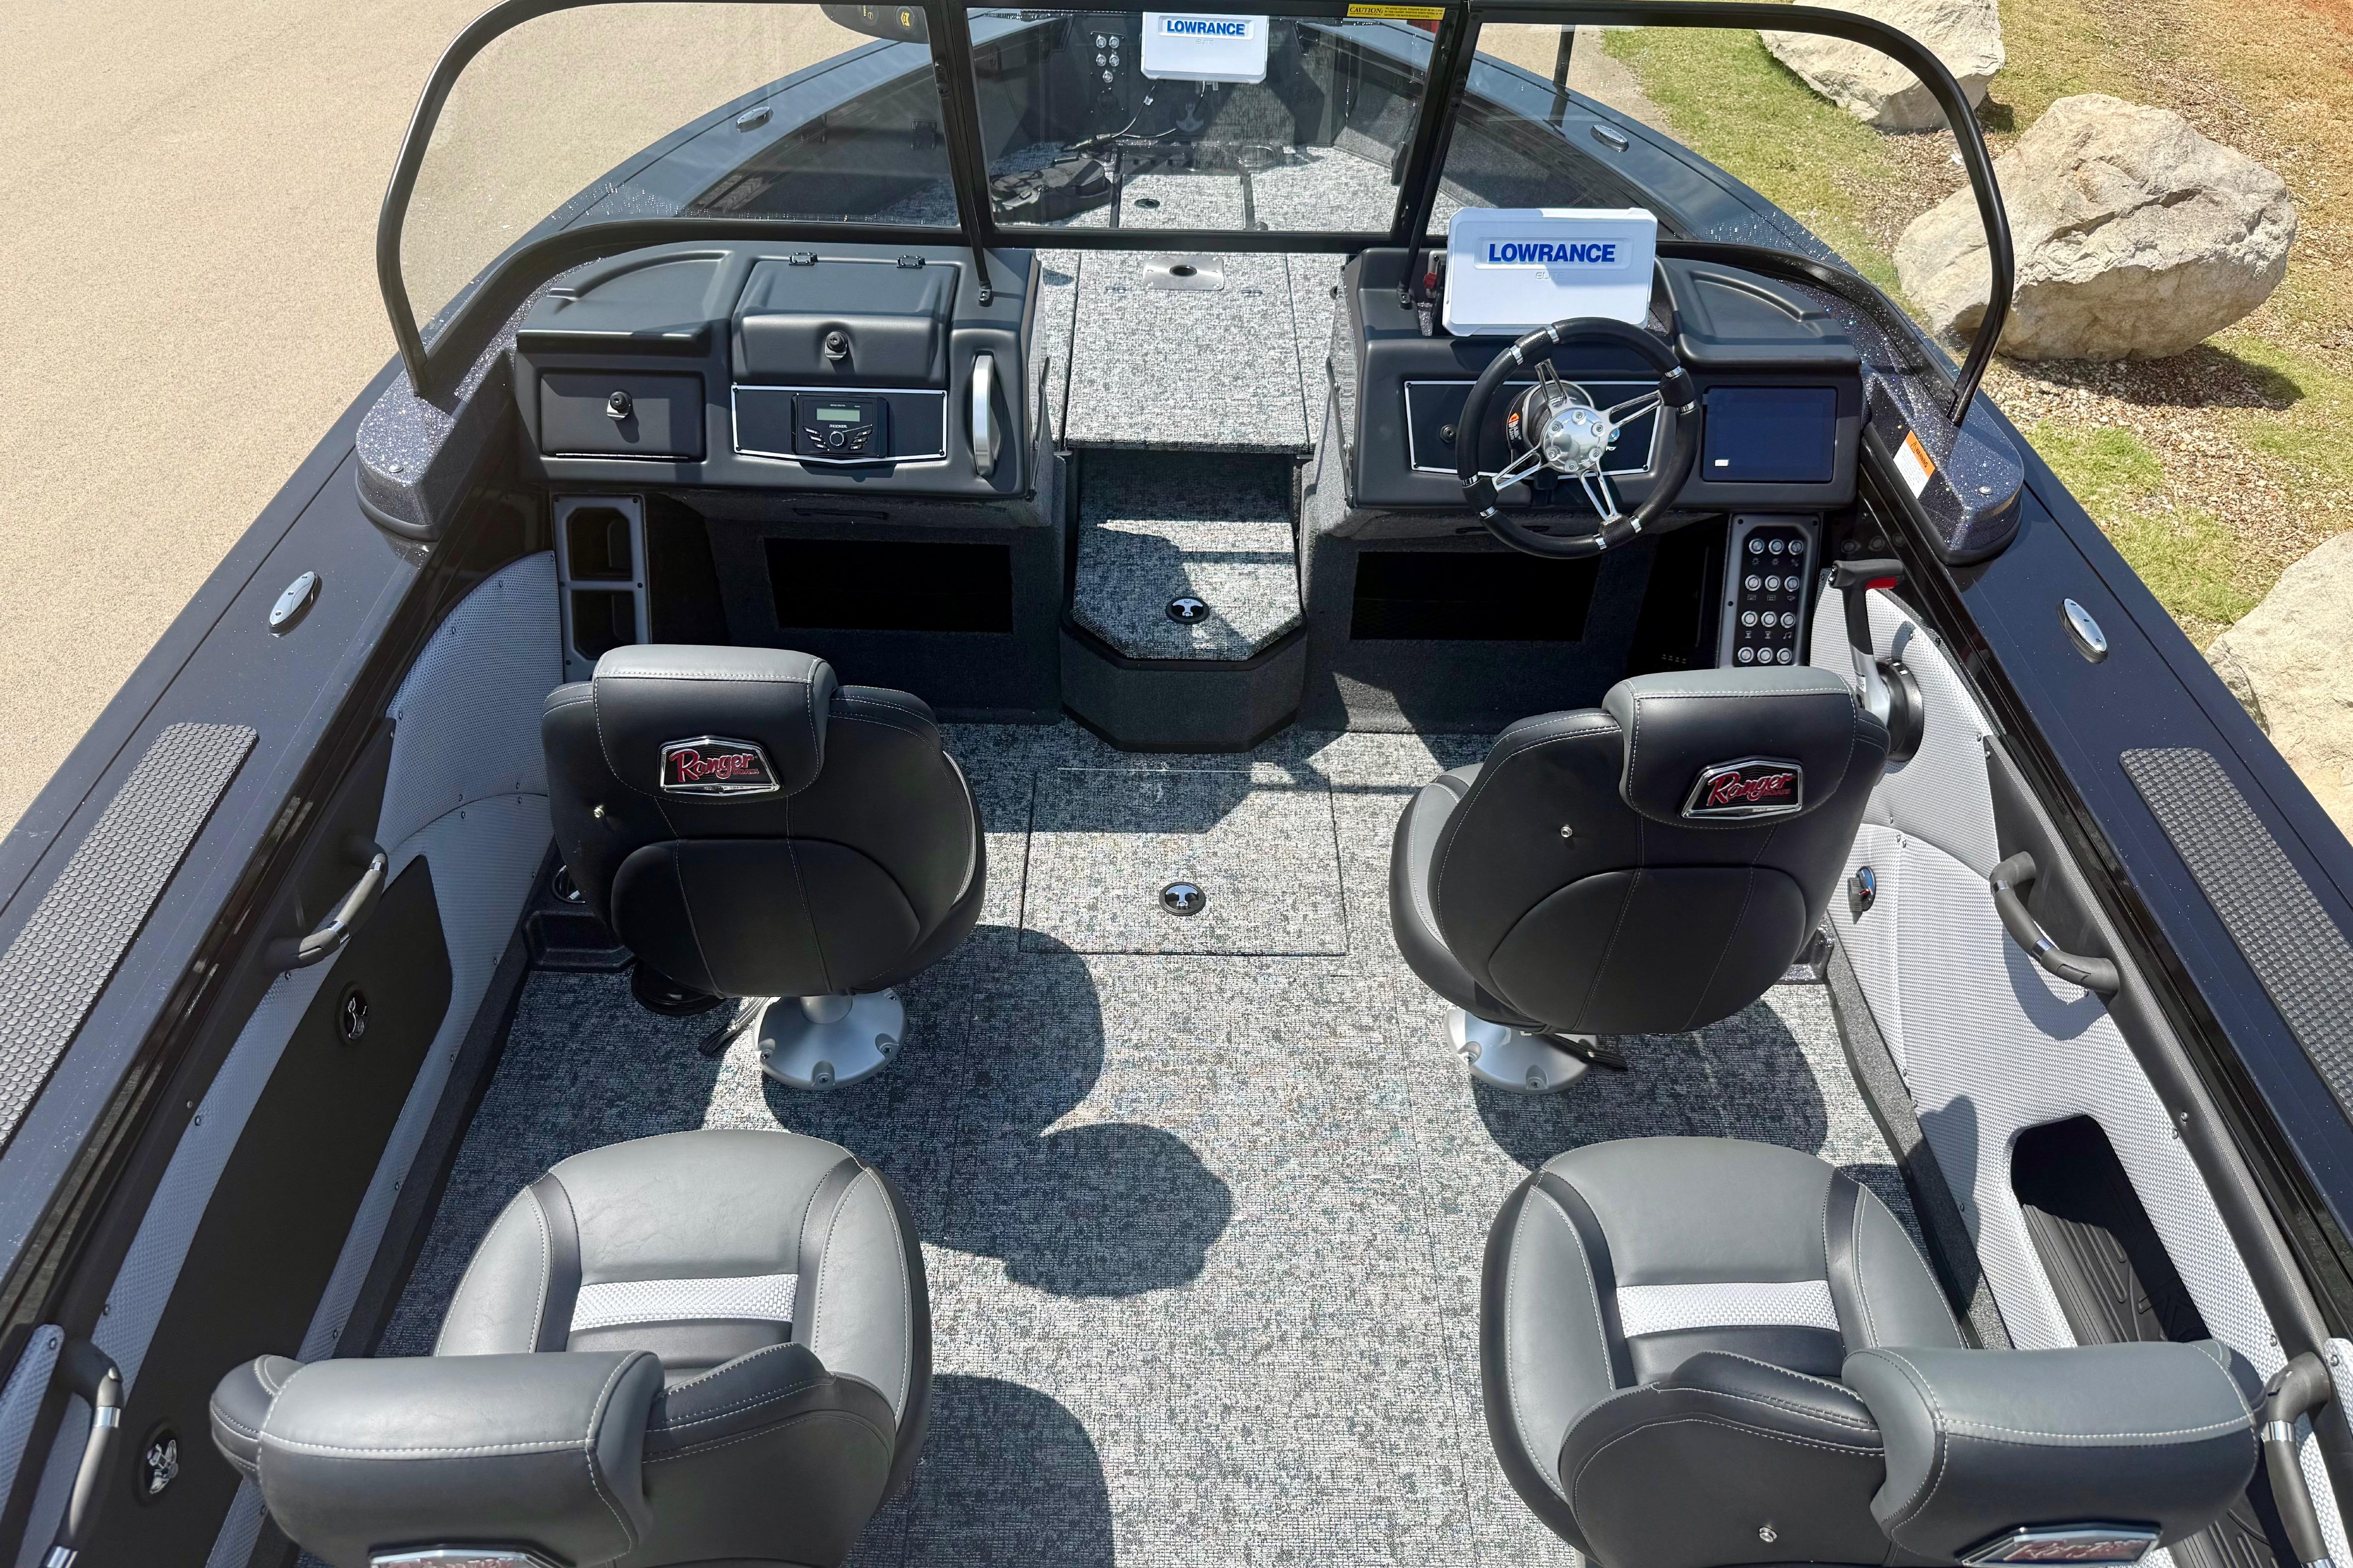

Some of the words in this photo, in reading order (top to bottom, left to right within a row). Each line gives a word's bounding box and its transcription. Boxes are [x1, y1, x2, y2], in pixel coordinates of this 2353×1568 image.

[1167, 20, 1245, 36] LOWRANCE
[1489, 243, 1616, 263] LOWRANCE
[1916, 447, 1928, 468] WARNING
[669, 748, 754, 783] Ranger
[1706, 771, 1796, 806] Ranger
